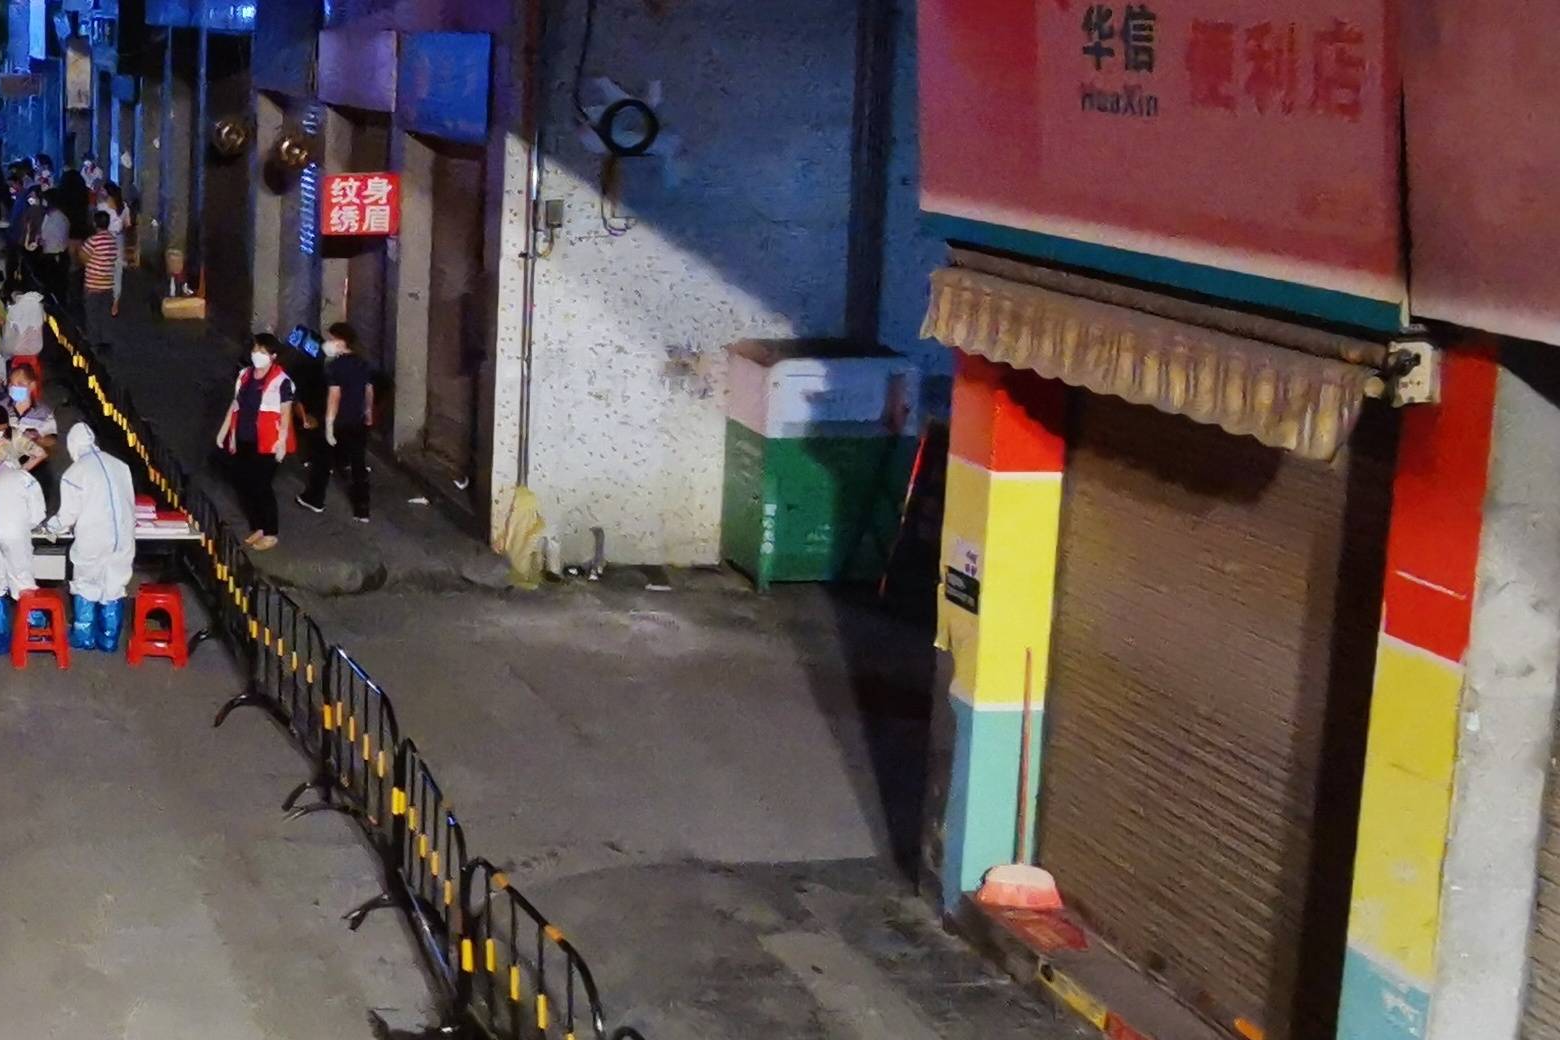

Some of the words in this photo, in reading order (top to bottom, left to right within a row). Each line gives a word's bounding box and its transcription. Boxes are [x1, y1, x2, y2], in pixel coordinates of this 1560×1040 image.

[1081, 3, 1157, 73] 华信
[1186, 18, 1366, 121] 便利店
[330, 176, 393, 205] 纹身
[329, 204, 391, 233] 绣眉
